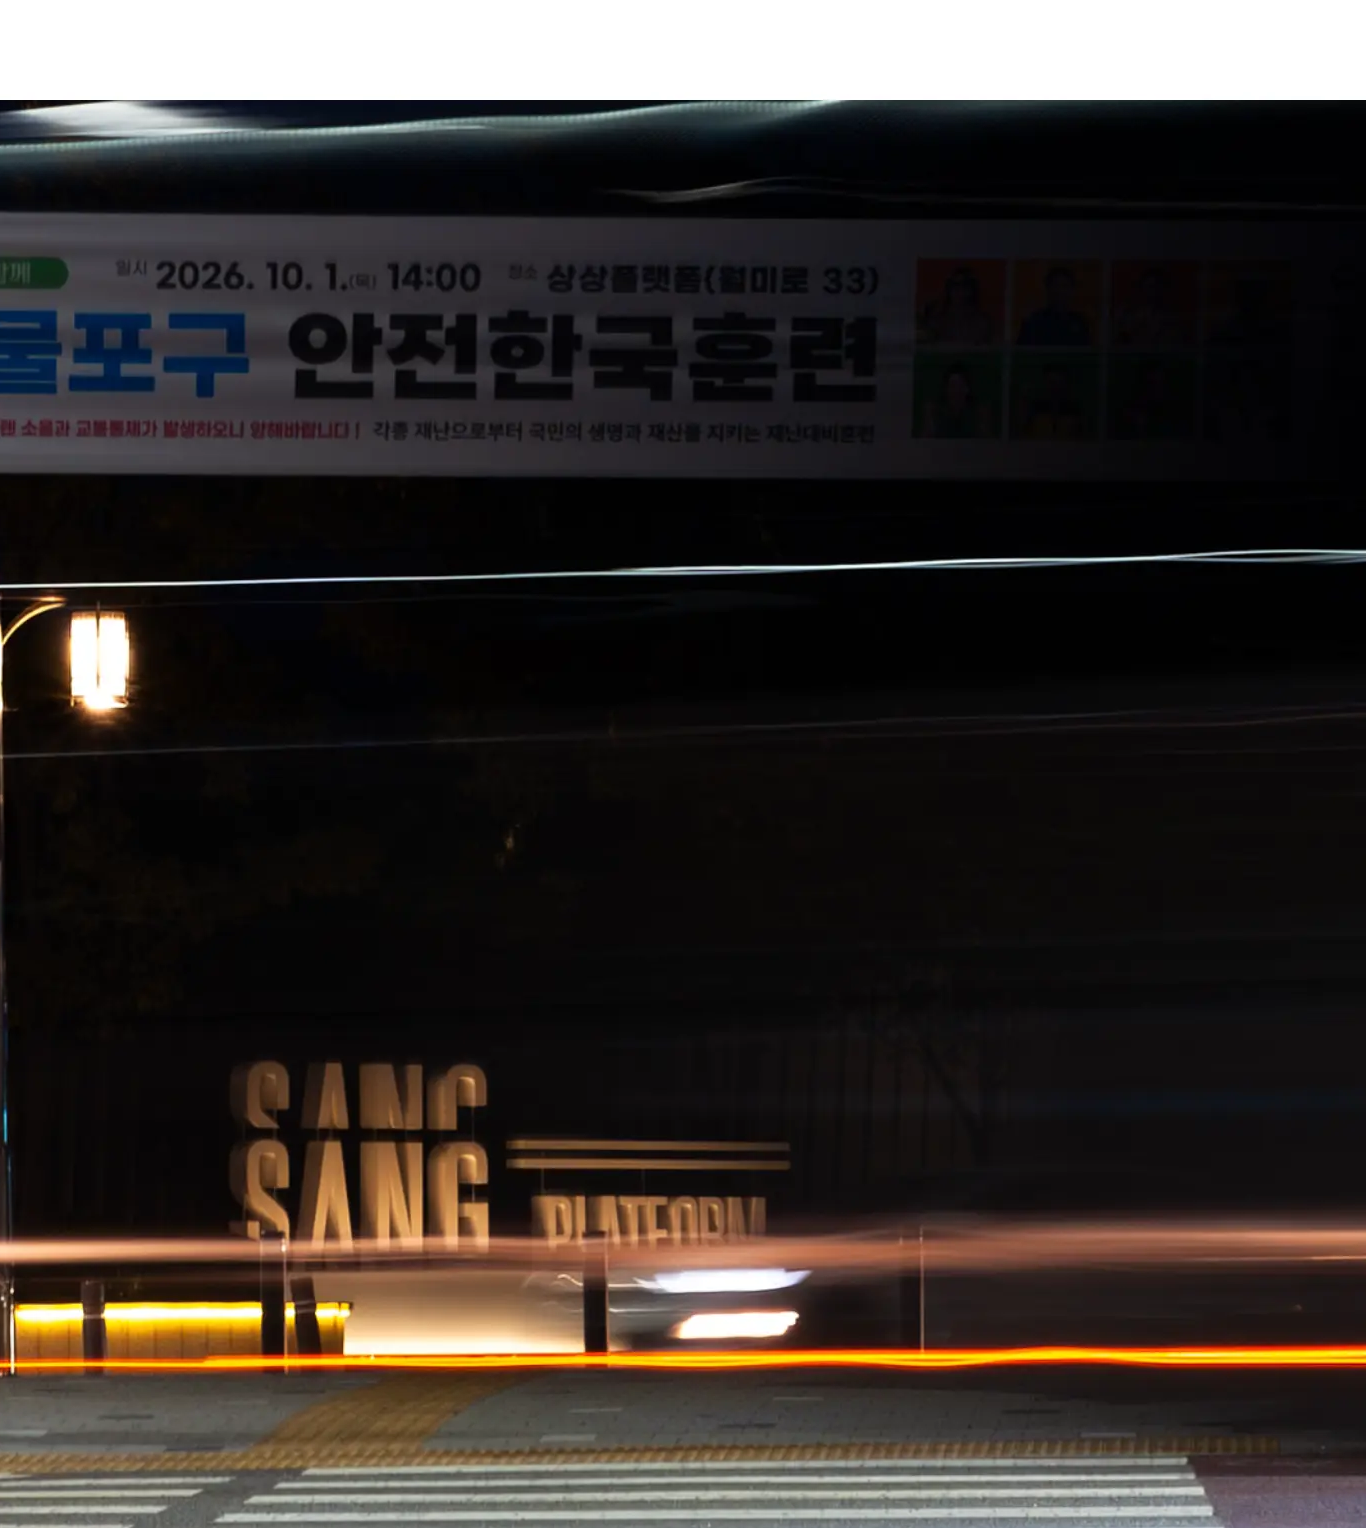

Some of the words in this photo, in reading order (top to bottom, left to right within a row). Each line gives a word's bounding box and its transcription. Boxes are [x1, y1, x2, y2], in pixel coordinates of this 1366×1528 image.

[115, 259, 147, 277] 일시
[156, 261, 254, 291] 2026.
[266, 261, 312, 292] 10.
[388, 262, 481, 293] 14:00
[823, 266, 879, 296] 33)
[288, 310, 878, 402] 안전한국훈련
[76, 419, 158, 438] 교통통제가
[163, 420, 245, 439] 발생하오니
[373, 421, 408, 441] 각종
[415, 421, 523, 442] 재난으로부터
[529, 421, 582, 442] 국민의
[588, 422, 642, 443] 생명과
[648, 423, 702, 443] 재산을
[707, 423, 761, 443] 지키는
[766, 423, 875, 444] 재난대비훈련
[230, 1138, 490, 1254] SANG
